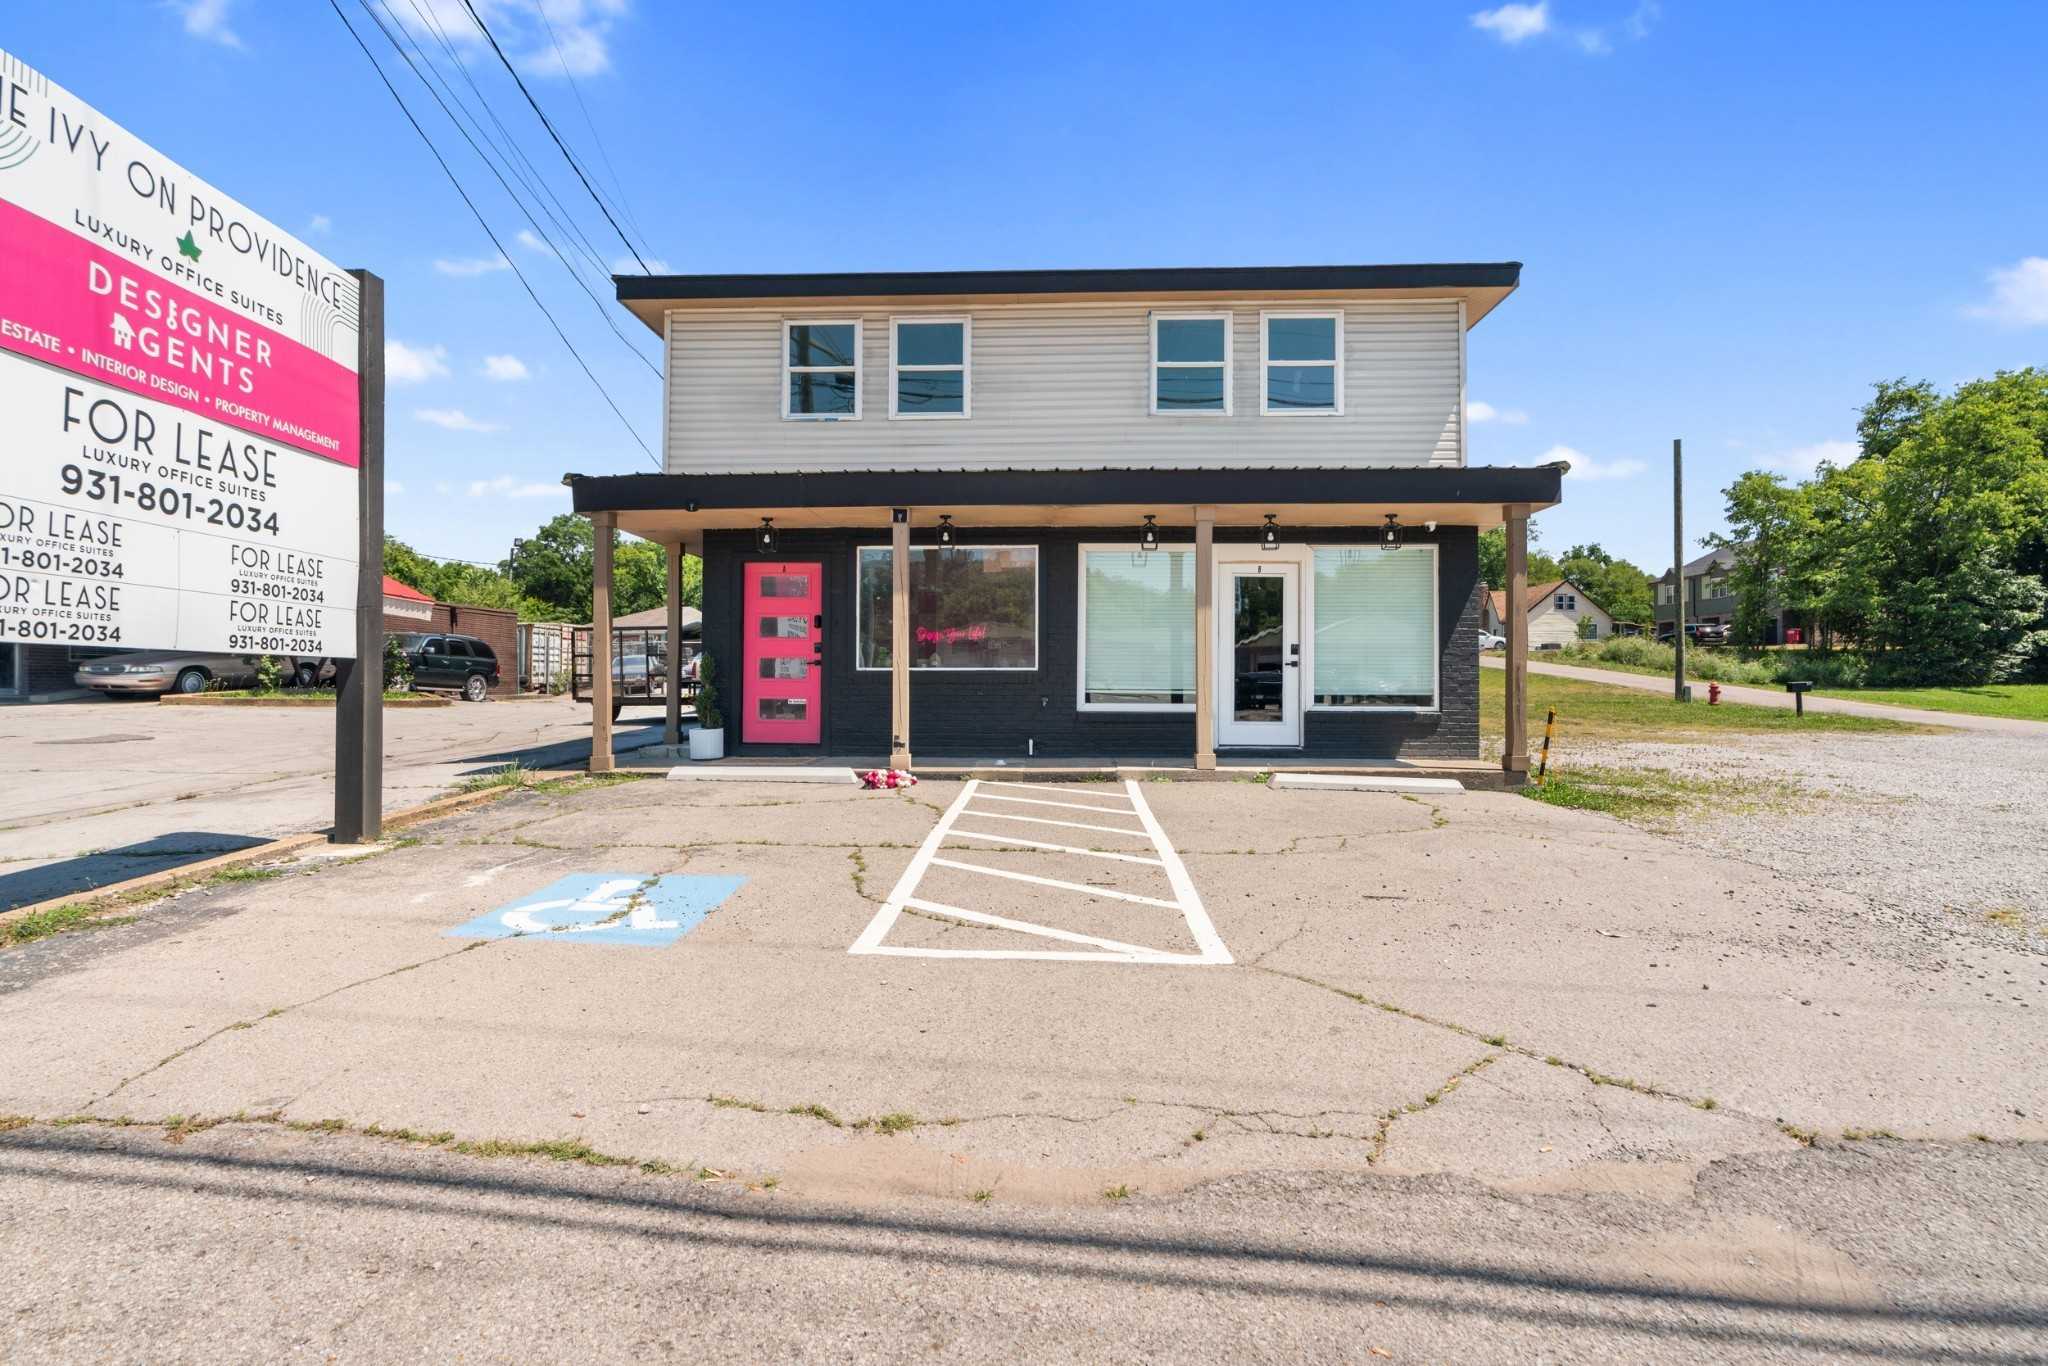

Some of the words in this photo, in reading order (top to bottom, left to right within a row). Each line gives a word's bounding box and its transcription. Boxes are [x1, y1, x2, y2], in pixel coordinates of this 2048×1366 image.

[0, 75, 28, 128] E
[50, 106, 110, 171] IVY
[128, 161, 175, 215] ON
[191, 195, 341, 310] PROVIDENCE
[75, 208, 153, 260] LUXURY
[161, 256, 224, 297] OFFICE
[230, 290, 284, 326] SUITES
[89, 261, 272, 368] DESIGNER
[1, 318, 61, 353] ESTATE
[81, 349, 147, 384] INTERIOR
[151, 375, 199, 403] DESIGN
[215, 397, 270, 427] PROPERTY
[272, 419, 340, 451] MANAGEMENT
[63, 386, 155, 456] FOR
[175, 422, 277, 488] LEASE
[83, 445, 152, 474] LUXURY
[158, 466, 213, 490] OFFICE
[218, 481, 266, 502] SUITES
[61, 464, 279, 536] 931-801-2034
[48, 511, 122, 547] LEASE
[1, 547, 124, 578] 1-801-2034
[36, 539, 76, 552] OFFICE
[79, 545, 114, 557] SUITES
[231, 544, 270, 570] FOR
[278, 552, 324, 579] LEASE
[231, 579, 324, 603] 931-801-2034
[239, 569, 268, 579] LUXURY
[270, 574, 295, 583] OFFICE
[297, 578, 318, 587] SUITES
[45, 580, 120, 611] LEASE
[32, 608, 72, 620] OFFICE
[76, 611, 112, 622] SUITES
[230, 600, 268, 624] FOR
[276, 605, 322, 628] LEASE
[0, 618, 121, 642] 1-801-2034
[229, 634, 322, 653] 931-801-2034
[237, 625, 266, 633] LUXURY
[269, 627, 293, 635] OFFICE
[295, 629, 316, 637] SUITES
